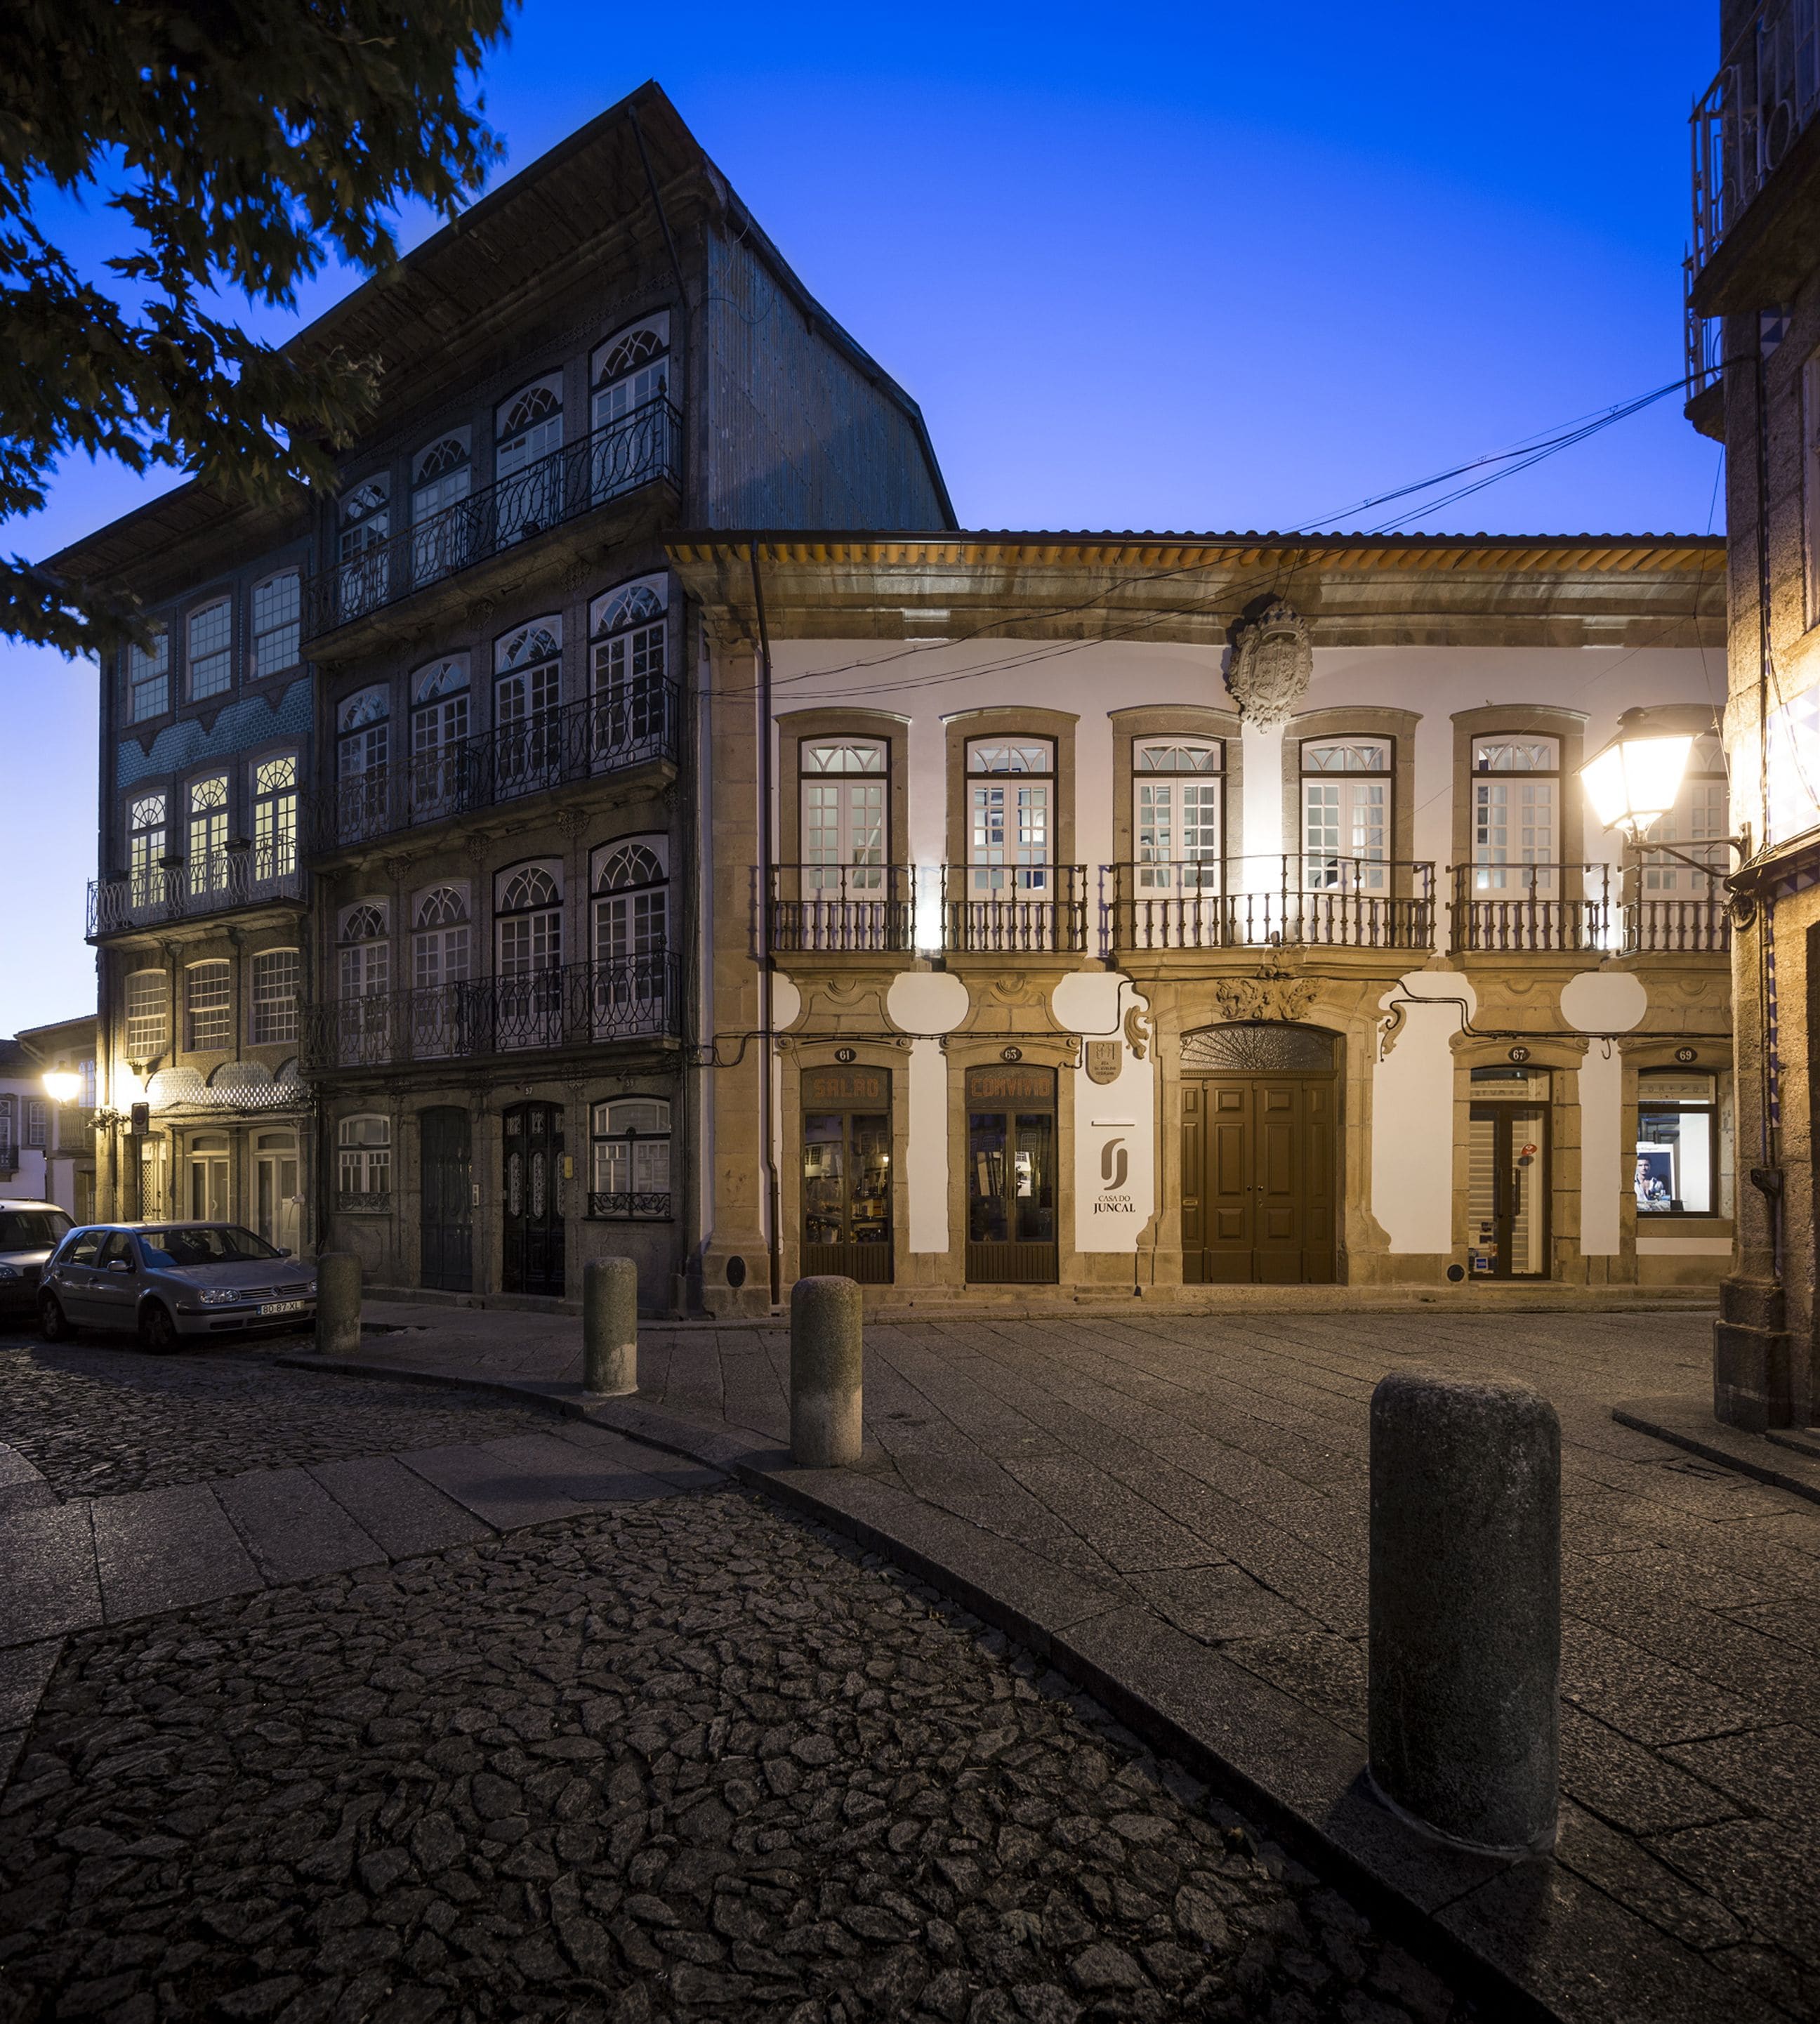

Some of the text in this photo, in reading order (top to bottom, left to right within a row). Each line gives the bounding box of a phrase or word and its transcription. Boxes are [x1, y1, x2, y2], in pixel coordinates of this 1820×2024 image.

[839, 1049, 850, 1060] 61
[1005, 1049, 1017, 1060] 63
[1512, 1049, 1524, 1060] 67
[1680, 1050, 1692, 1060] 69
[626, 1078, 634, 1086] 59
[1093, 1203, 1136, 1214] JUNCAL
